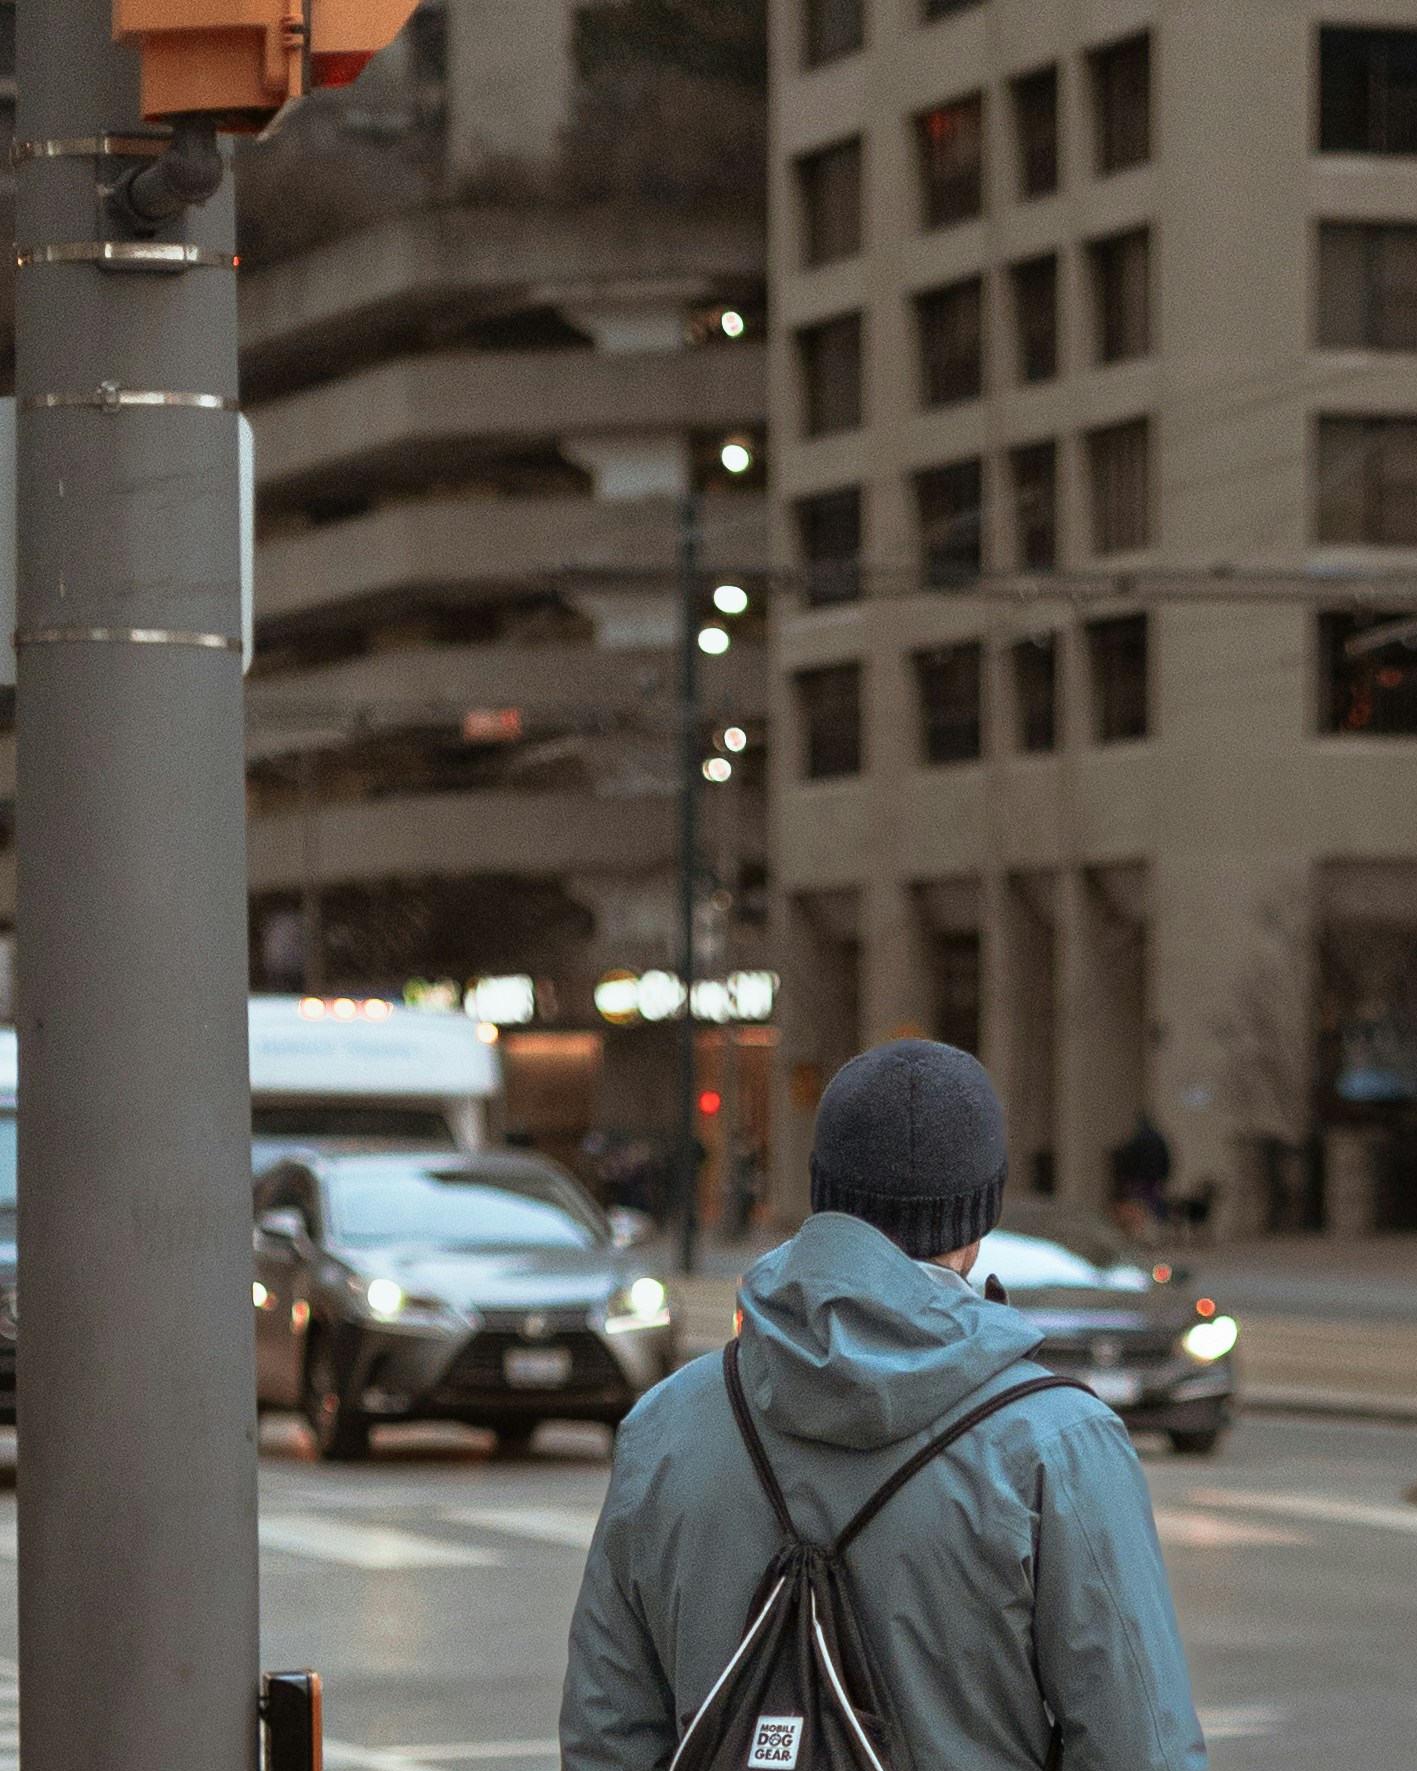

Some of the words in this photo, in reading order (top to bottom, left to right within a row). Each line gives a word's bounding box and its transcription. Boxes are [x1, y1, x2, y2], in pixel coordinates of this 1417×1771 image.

[760, 1723, 796, 1733] MOBILE
[757, 1733, 793, 1747] DOG
[754, 1749, 791, 1761] GEAR
